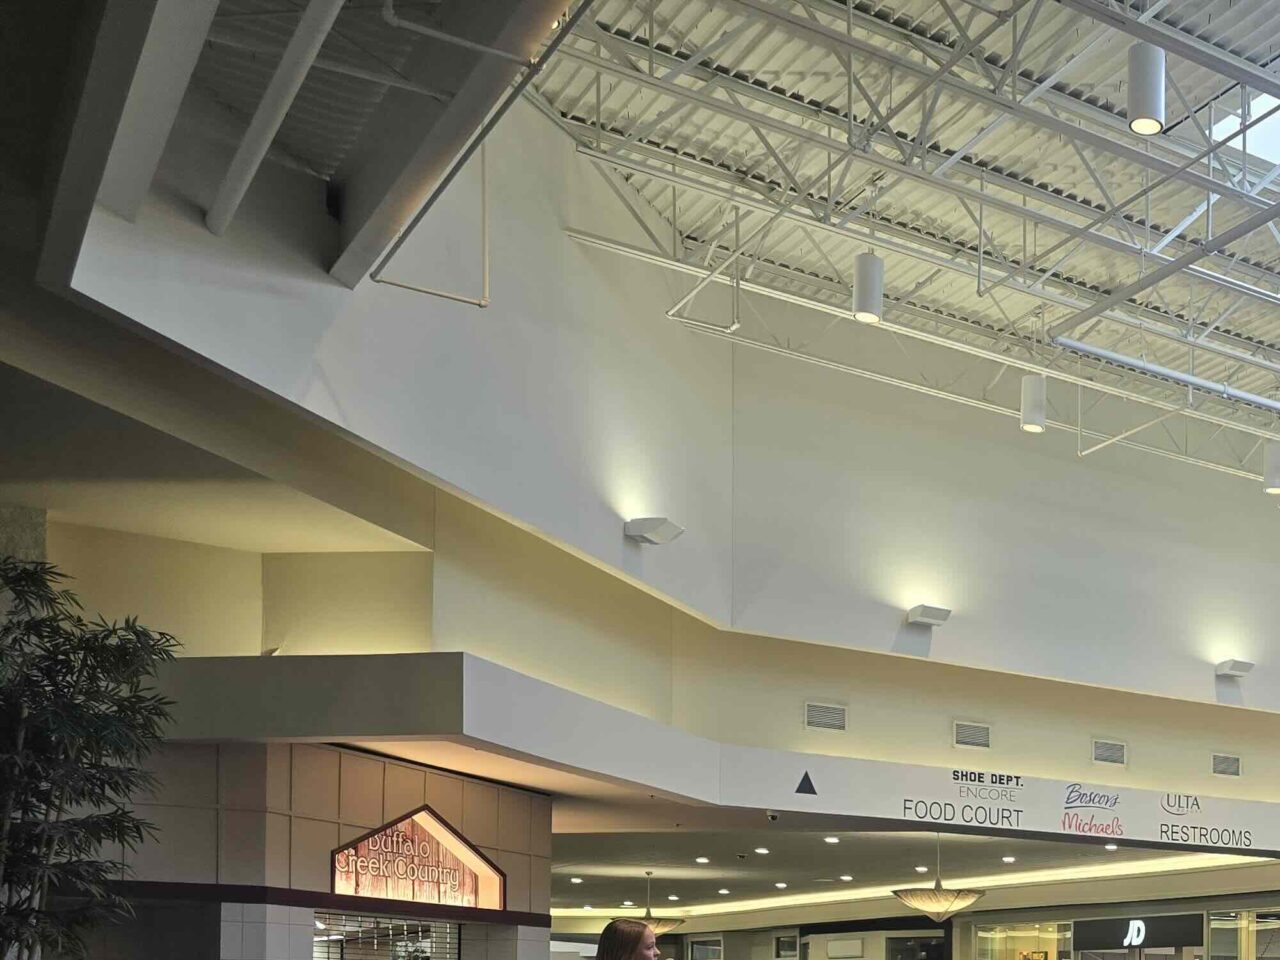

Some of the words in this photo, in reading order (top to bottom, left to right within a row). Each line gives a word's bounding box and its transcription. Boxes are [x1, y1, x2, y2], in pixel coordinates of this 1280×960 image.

[952, 769, 985, 784] SHOE
[990, 773, 1024, 787] DEPT.
[959, 785, 1017, 802] ENCORE
[1166, 793, 1201, 810] ULTA
[903, 799, 955, 822] FOOD
[961, 803, 1024, 828] COURT
[1060, 811, 1123, 836] Michaels
[368, 831, 430, 858] Buffalo
[1160, 823, 1252, 847] RESTROOMS
[335, 851, 390, 878] Creek
[394, 857, 459, 891] Country
[1123, 920, 1146, 947] JD
